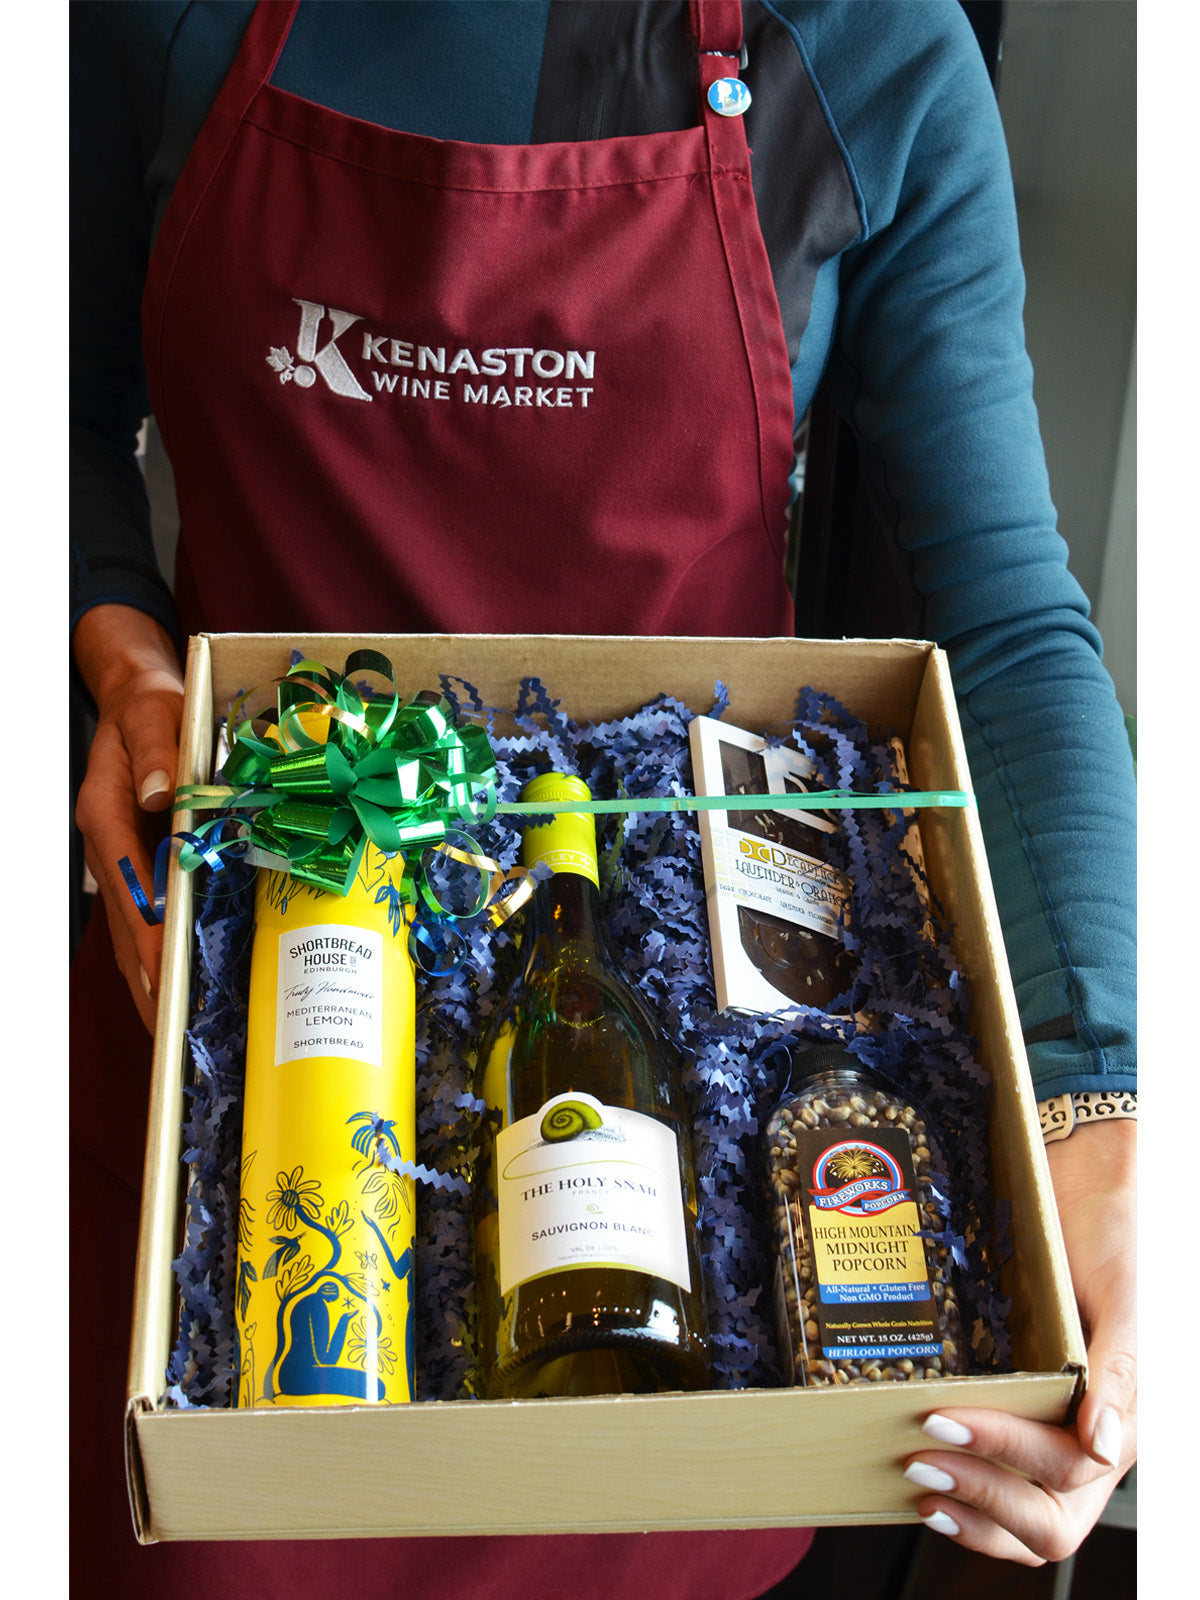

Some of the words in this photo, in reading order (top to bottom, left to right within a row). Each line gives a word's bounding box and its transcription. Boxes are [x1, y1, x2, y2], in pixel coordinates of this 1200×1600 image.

[361, 332, 596, 380] KENASTON
[371, 370, 450, 401] WINE
[463, 383, 594, 409] MARKET
[735, 859, 796, 889] LAVENDER
[801, 881, 842, 908] ORANG
[289, 937, 372, 960] SHORTBREAD
[304, 953, 347, 966] HOUSE
[303, 966, 357, 974] EDINBURGH
[284, 984, 313, 1002] Truly
[286, 1005, 372, 1019] MEDITERRANEAN
[305, 1016, 353, 1026] LEMON
[293, 1037, 364, 1049] SHORTBREAD
[521, 1182, 554, 1201] THE
[559, 1177, 607, 1190] HOLY
[818, 1180, 889, 1207] FIREWORKS
[864, 1192, 906, 1210] POPCORN
[531, 1221, 608, 1241] SAUVIGNON
[613, 1222, 655, 1238] BLANC
[814, 1226, 845, 1240] HIGH
[849, 1224, 916, 1239] MOUNTAIN
[826, 1240, 909, 1256] MIDNIGHT
[833, 1256, 907, 1272] POPCORN
[826, 1285, 870, 1293] All-Natural
[879, 1284, 906, 1292] Gluten
[908, 1283, 925, 1291] Free
[840, 1294, 857, 1302] Non
[859, 1293, 882, 1301] GMO
[883, 1292, 914, 1301] Product
[825, 1322, 851, 1330] Naturally
[907, 1319, 934, 1327] Nutrition
[837, 1335, 857, 1344] NET
[859, 1334, 877, 1343] WT.
[878, 1334, 888, 1342] 15
[889, 1334, 906, 1342] OZ.
[828, 1348, 886, 1357] HEIRLOOM
[888, 1345, 939, 1355] POPCORN
